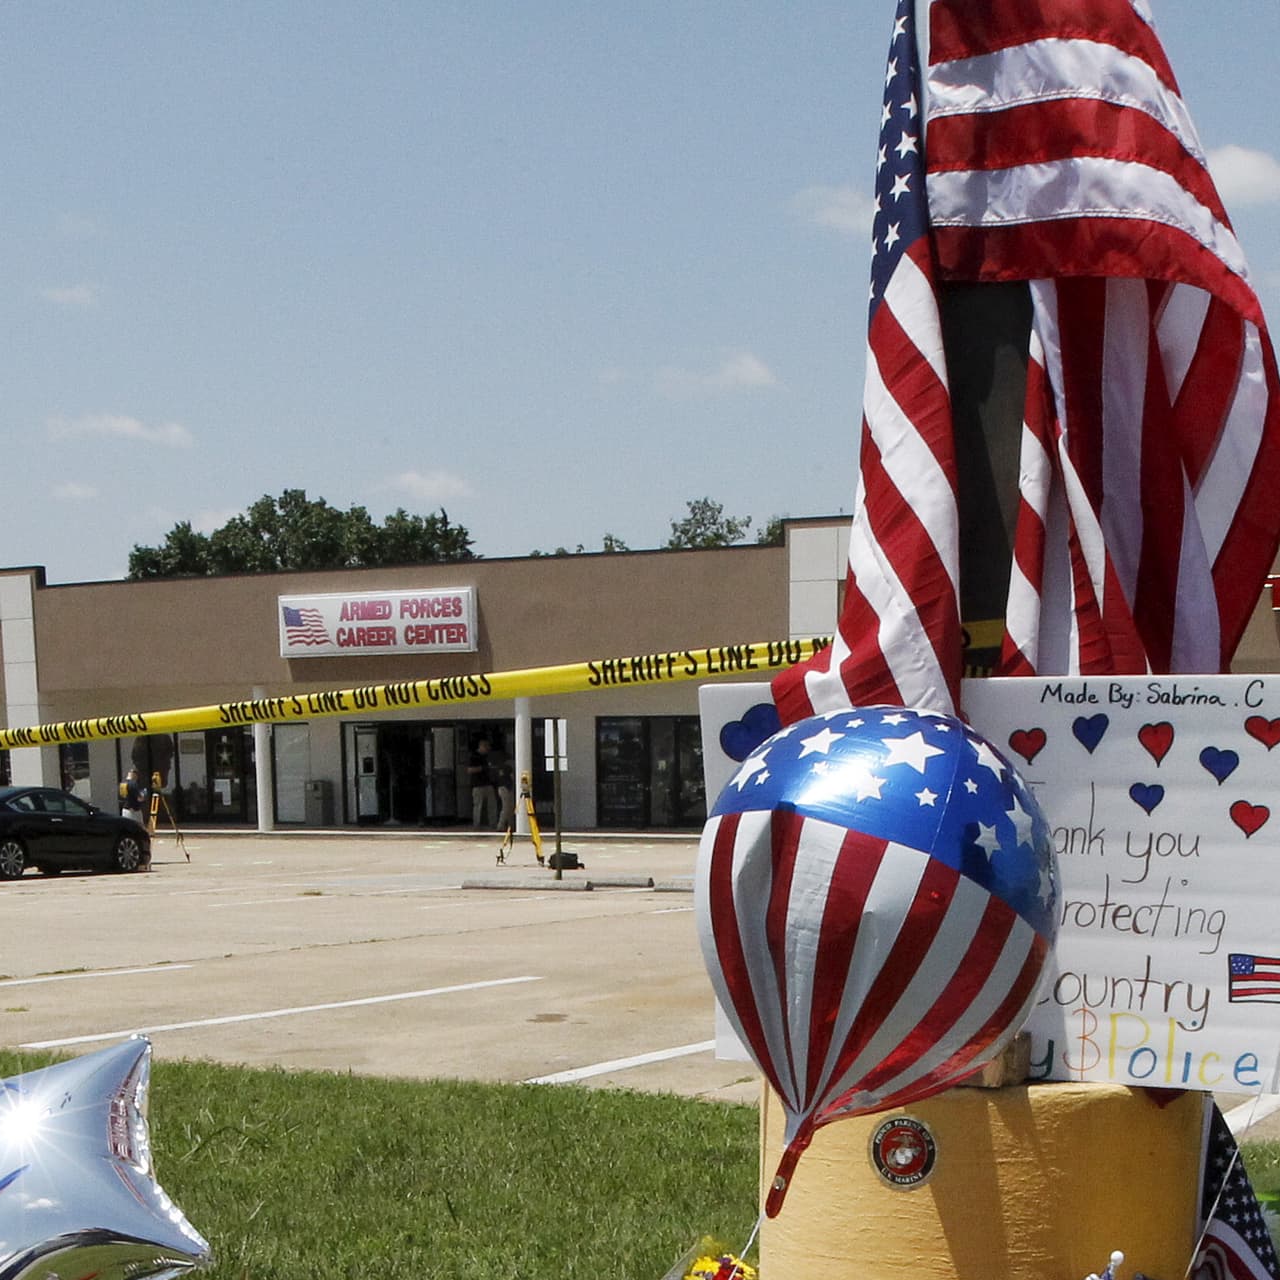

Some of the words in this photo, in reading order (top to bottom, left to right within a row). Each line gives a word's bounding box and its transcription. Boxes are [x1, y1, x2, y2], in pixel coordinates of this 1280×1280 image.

[339, 599, 392, 621] ARMED
[400, 597, 463, 619] FORCES
[336, 625, 397, 647] CAREER
[404, 623, 467, 645] CENTER
[588, 651, 697, 686] SHERIFF'S
[706, 645, 758, 674] LINE
[768, 640, 801, 666] DO
[308, 691, 348, 713] LINE
[385, 682, 420, 706] NOT
[427, 674, 492, 699] CROSS
[1041, 682, 1099, 704] Made
[1109, 683, 1141, 709] By:
[1147, 682, 1226, 707] Sabrina
[1121, 830, 1200, 884] you
[1061, 873, 1226, 955] rotecting
[1038, 955, 1210, 1032] ountry
[1108, 1012, 1262, 1087] Police
